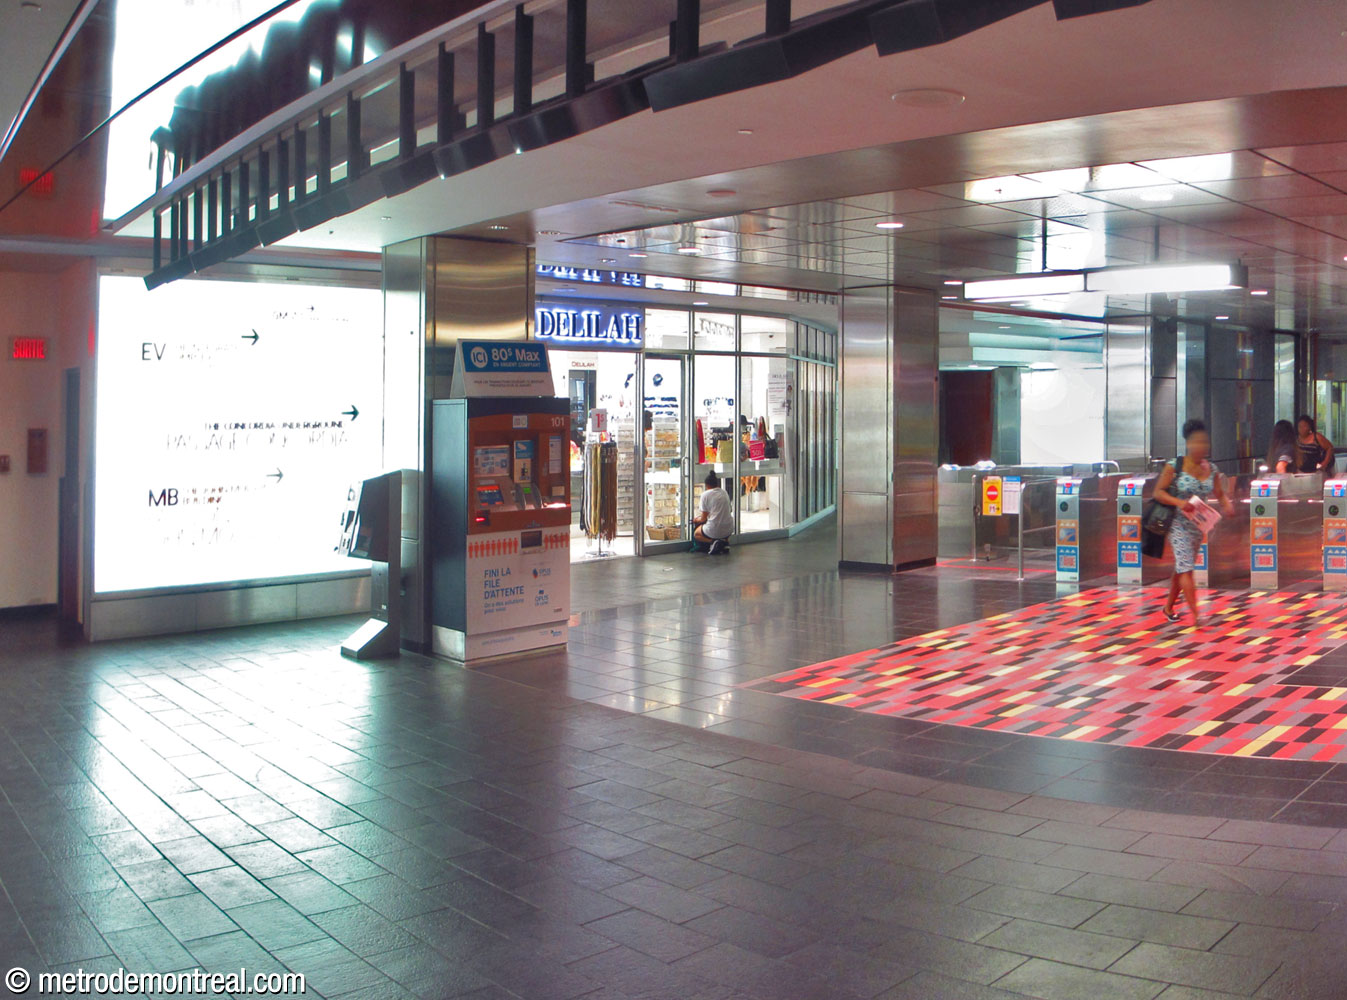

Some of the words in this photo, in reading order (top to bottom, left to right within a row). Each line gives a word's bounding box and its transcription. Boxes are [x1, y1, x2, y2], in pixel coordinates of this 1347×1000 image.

[538, 310, 642, 341] DELILAH
[142, 343, 166, 361] EV
[516, 349, 540, 361] Max
[551, 417, 565, 427] 101
[148, 488, 179, 507] MB
[484, 569, 499, 578] FINI
[501, 567, 511, 576] LA
[484, 579, 500, 589] FILE
[484, 586, 524, 600] D'ATTENTE
